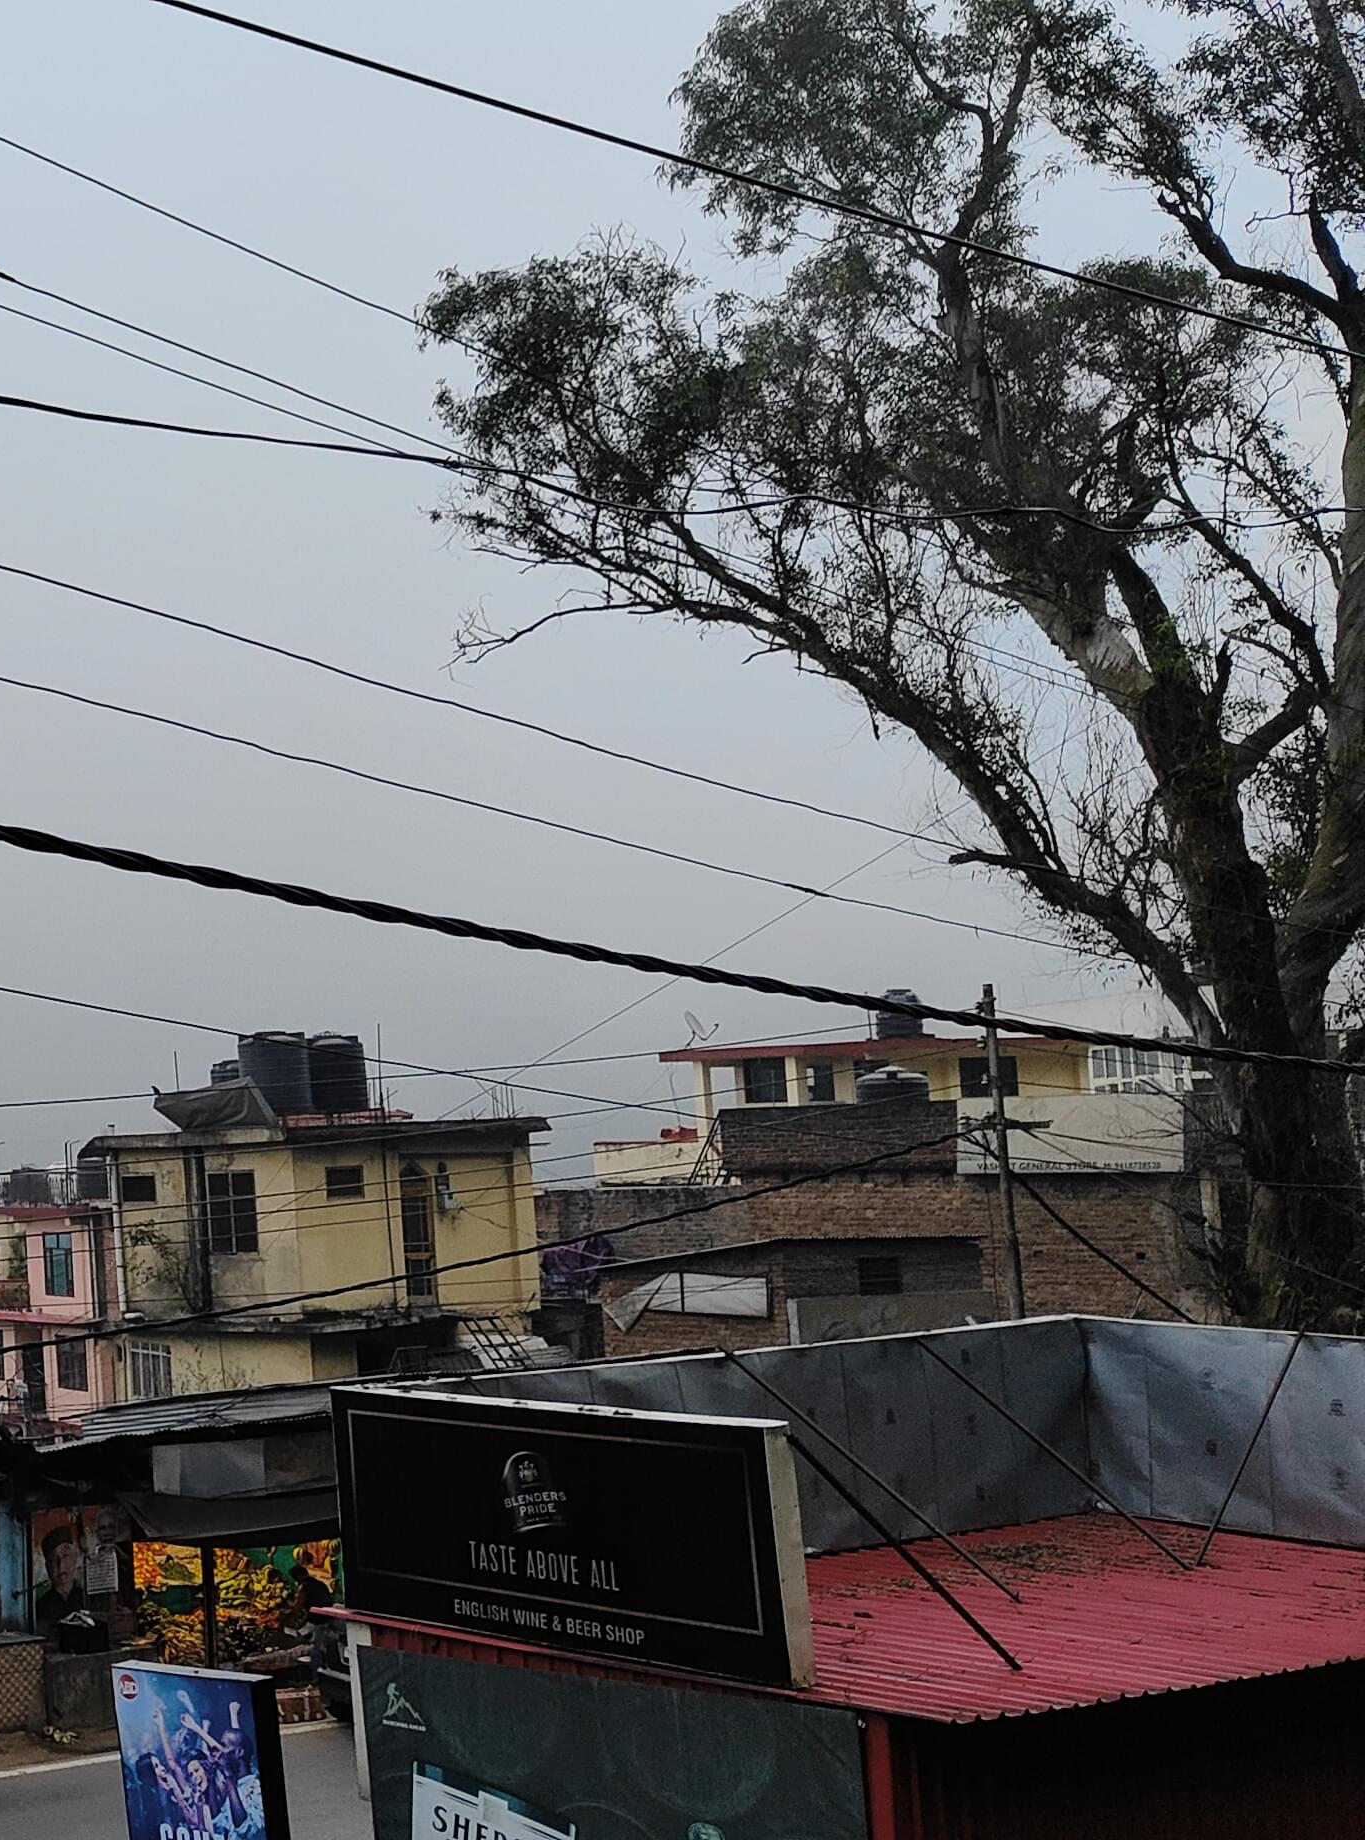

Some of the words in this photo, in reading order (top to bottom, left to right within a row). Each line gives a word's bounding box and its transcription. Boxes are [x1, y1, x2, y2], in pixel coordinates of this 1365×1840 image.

[1019, 1162, 1064, 1170] GENERAL
[503, 1491, 567, 1508] BLENDERS
[518, 1502, 556, 1516] PRIDE
[469, 1540, 517, 1576] TASTE
[526, 1549, 580, 1585] ABOVE
[590, 1559, 620, 1591] ALL
[454, 1599, 509, 1622] ENGLISH
[512, 1608, 548, 1630] WINE
[552, 1615, 562, 1632] &
[566, 1617, 602, 1639] BEER
[605, 1624, 645, 1646] SHOP
